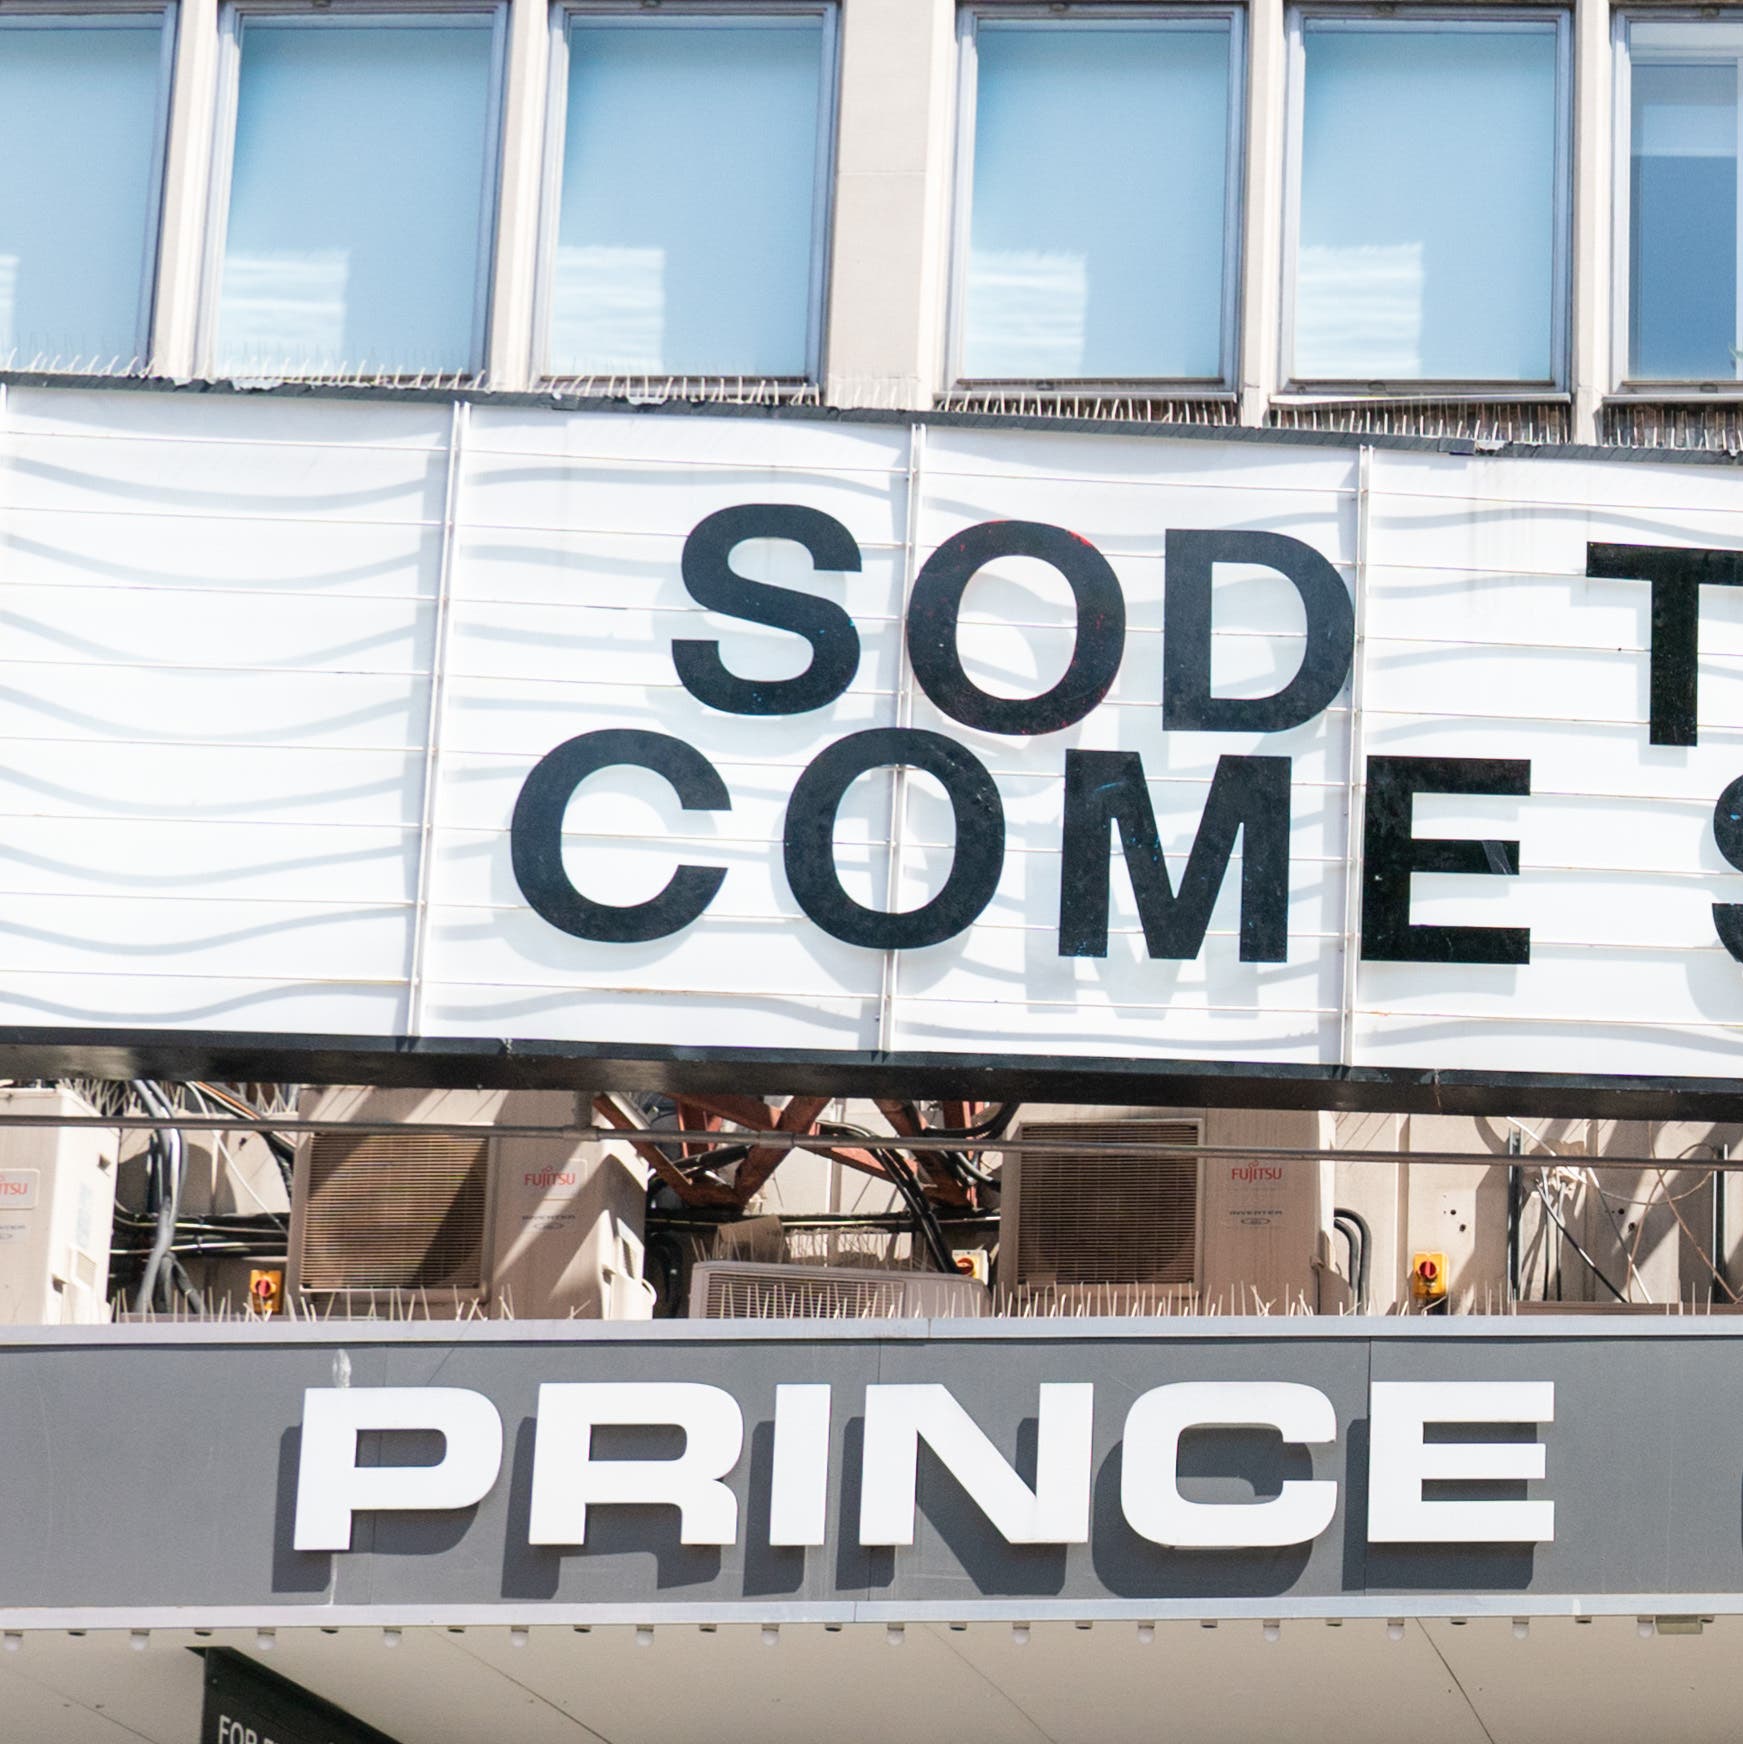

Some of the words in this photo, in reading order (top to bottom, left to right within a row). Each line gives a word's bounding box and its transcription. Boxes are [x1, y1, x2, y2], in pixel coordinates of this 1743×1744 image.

[670, 502, 1355, 737] SOD
[509, 726, 1531, 965] COME
[523, 1170, 576, 1188] FUJITSU
[1231, 1166, 1283, 1183] FUJITSU
[290, 1379, 1556, 1553] PRINCE
